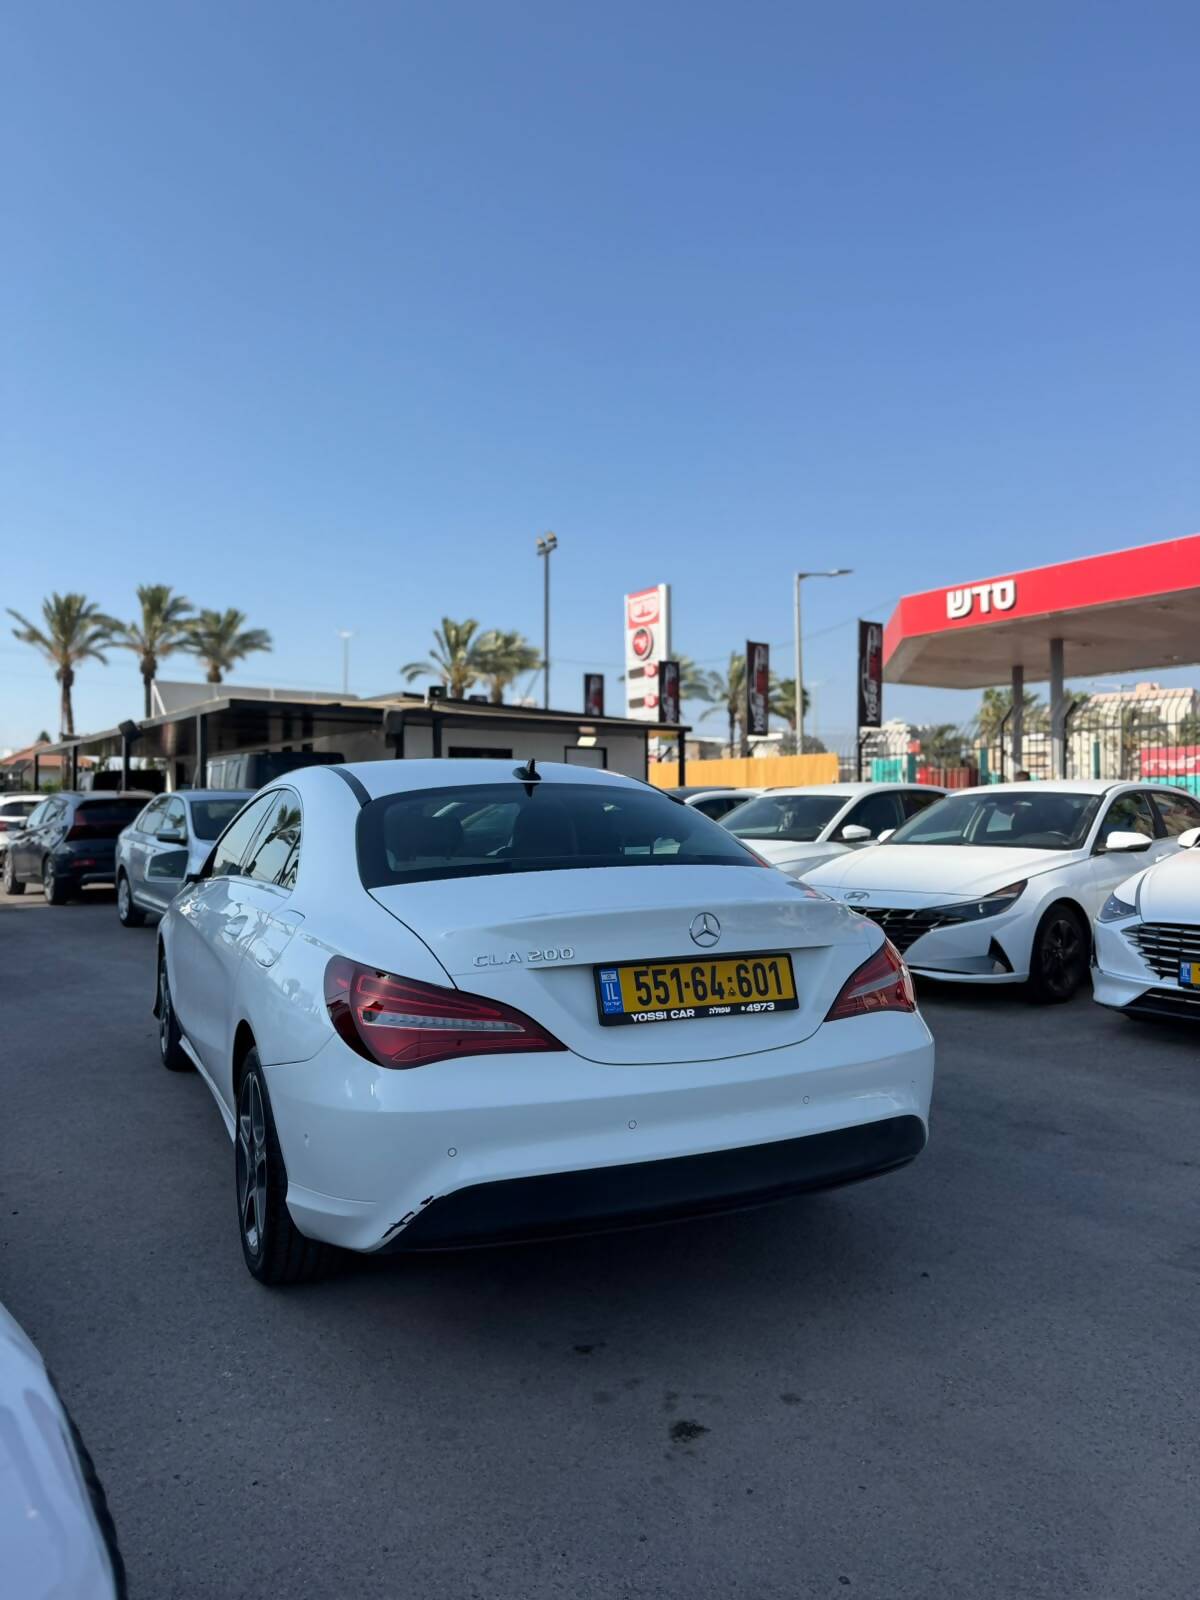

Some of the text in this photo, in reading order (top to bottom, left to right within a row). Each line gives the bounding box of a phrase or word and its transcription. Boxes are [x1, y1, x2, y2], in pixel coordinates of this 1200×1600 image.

[472, 947, 575, 967] CLA 200
[605, 982, 619, 1001] IL
[631, 1010, 667, 1023] YOSSI
[670, 1009, 695, 1020] CAR
